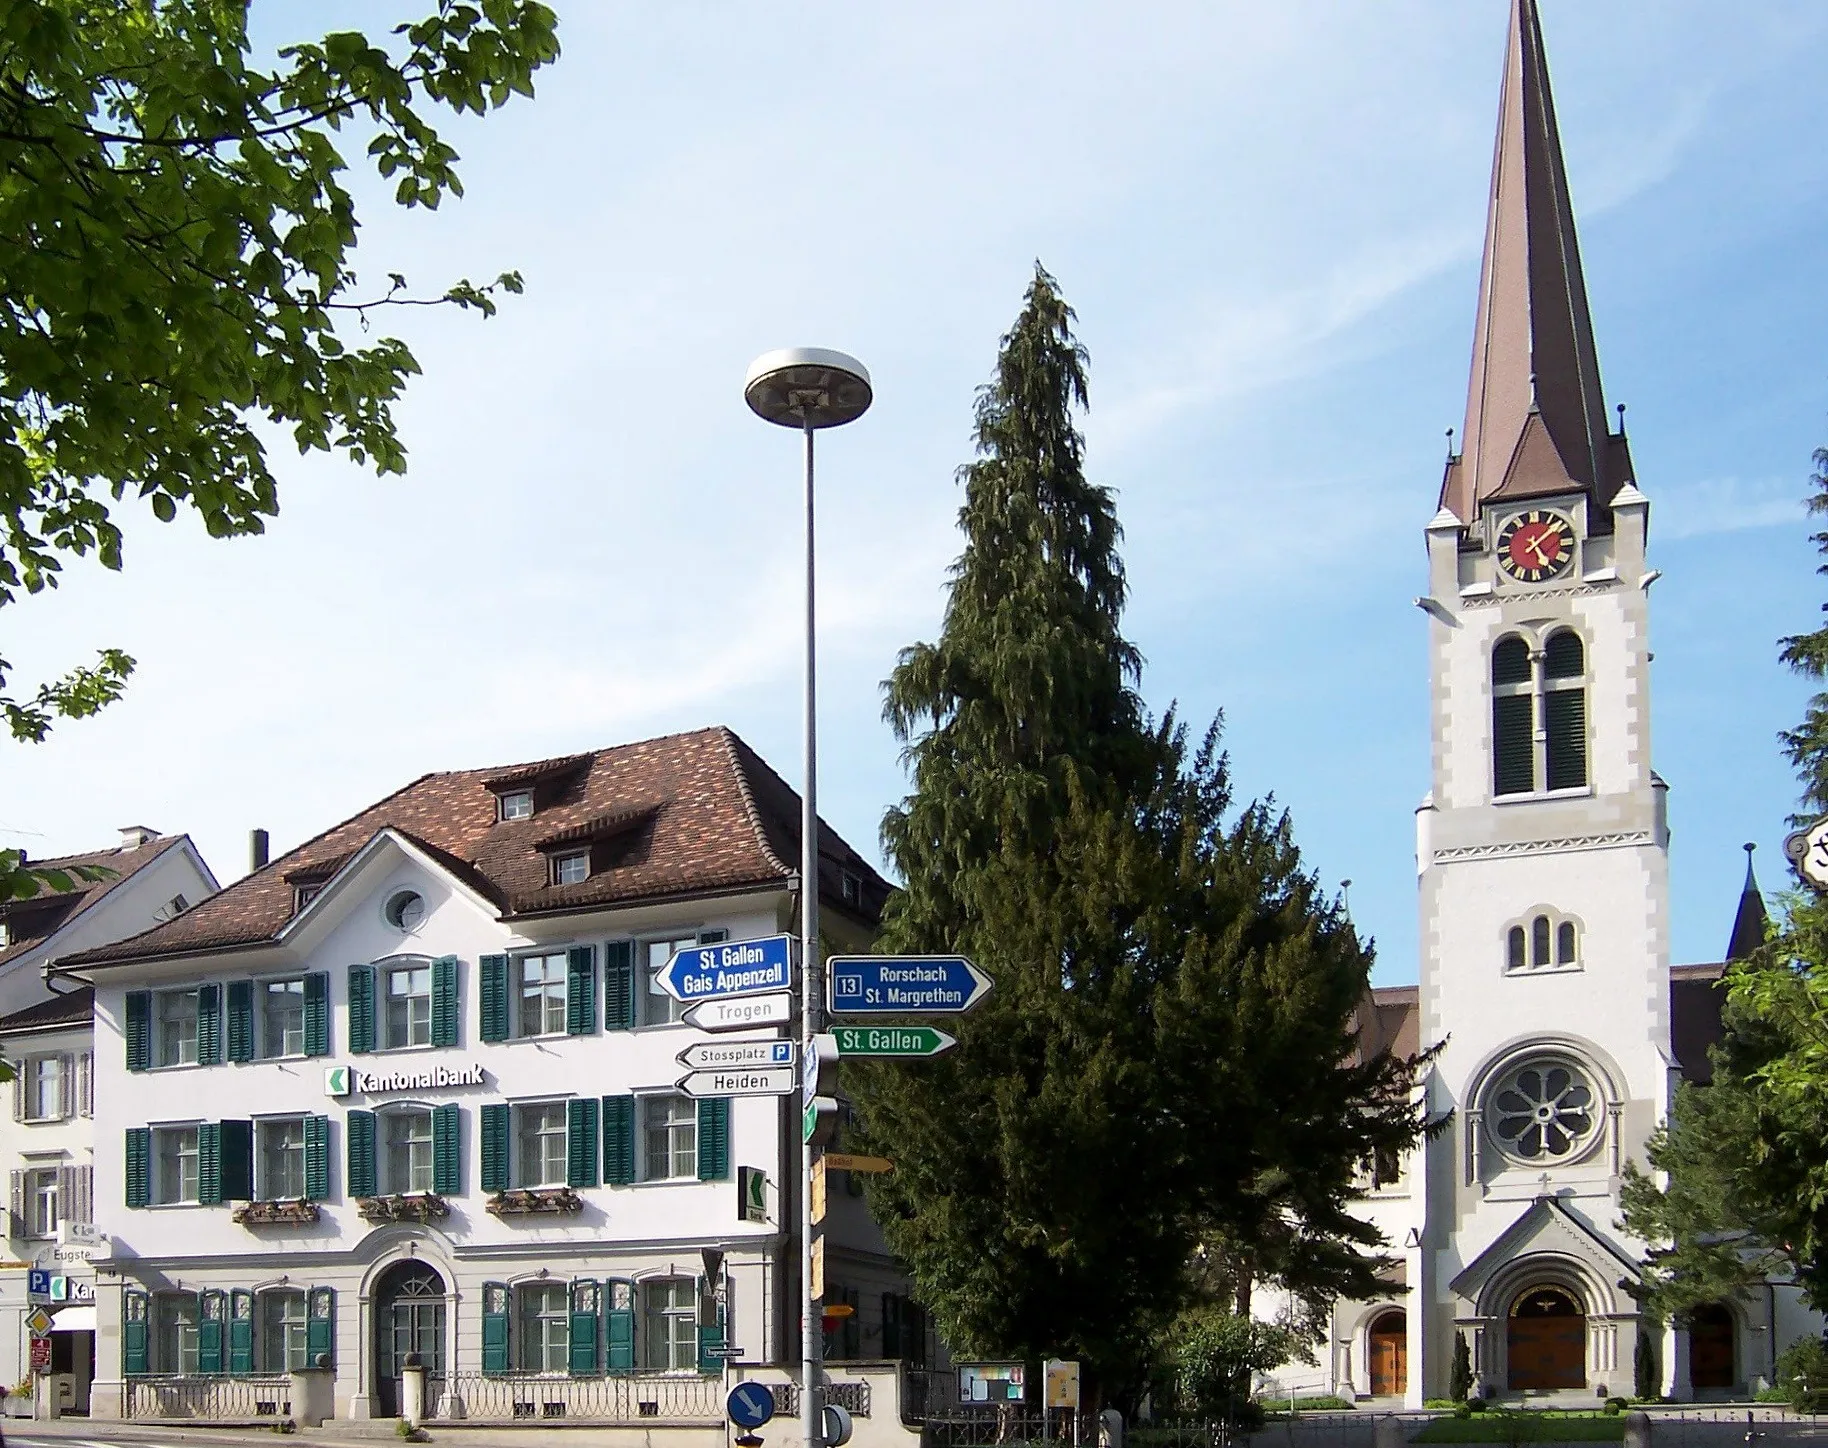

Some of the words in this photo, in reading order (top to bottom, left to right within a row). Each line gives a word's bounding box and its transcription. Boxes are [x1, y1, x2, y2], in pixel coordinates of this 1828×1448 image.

[700, 950, 719, 970] St.
[722, 945, 764, 967] Gallen
[683, 973, 713, 994] Gais
[716, 962, 782, 992] Appenzell
[880, 966, 947, 982] Rorschach
[841, 978, 856, 993] 13
[865, 988, 884, 1004] St.
[887, 987, 962, 1006] Margrethen
[717, 1003, 772, 1020] Trogen
[843, 1030, 865, 1049] St.
[868, 1030, 922, 1049] Gallen
[701, 1048, 766, 1063] Stossplatz
[355, 1063, 484, 1093] Kantonalbank
[714, 1074, 769, 1089] Heiden
